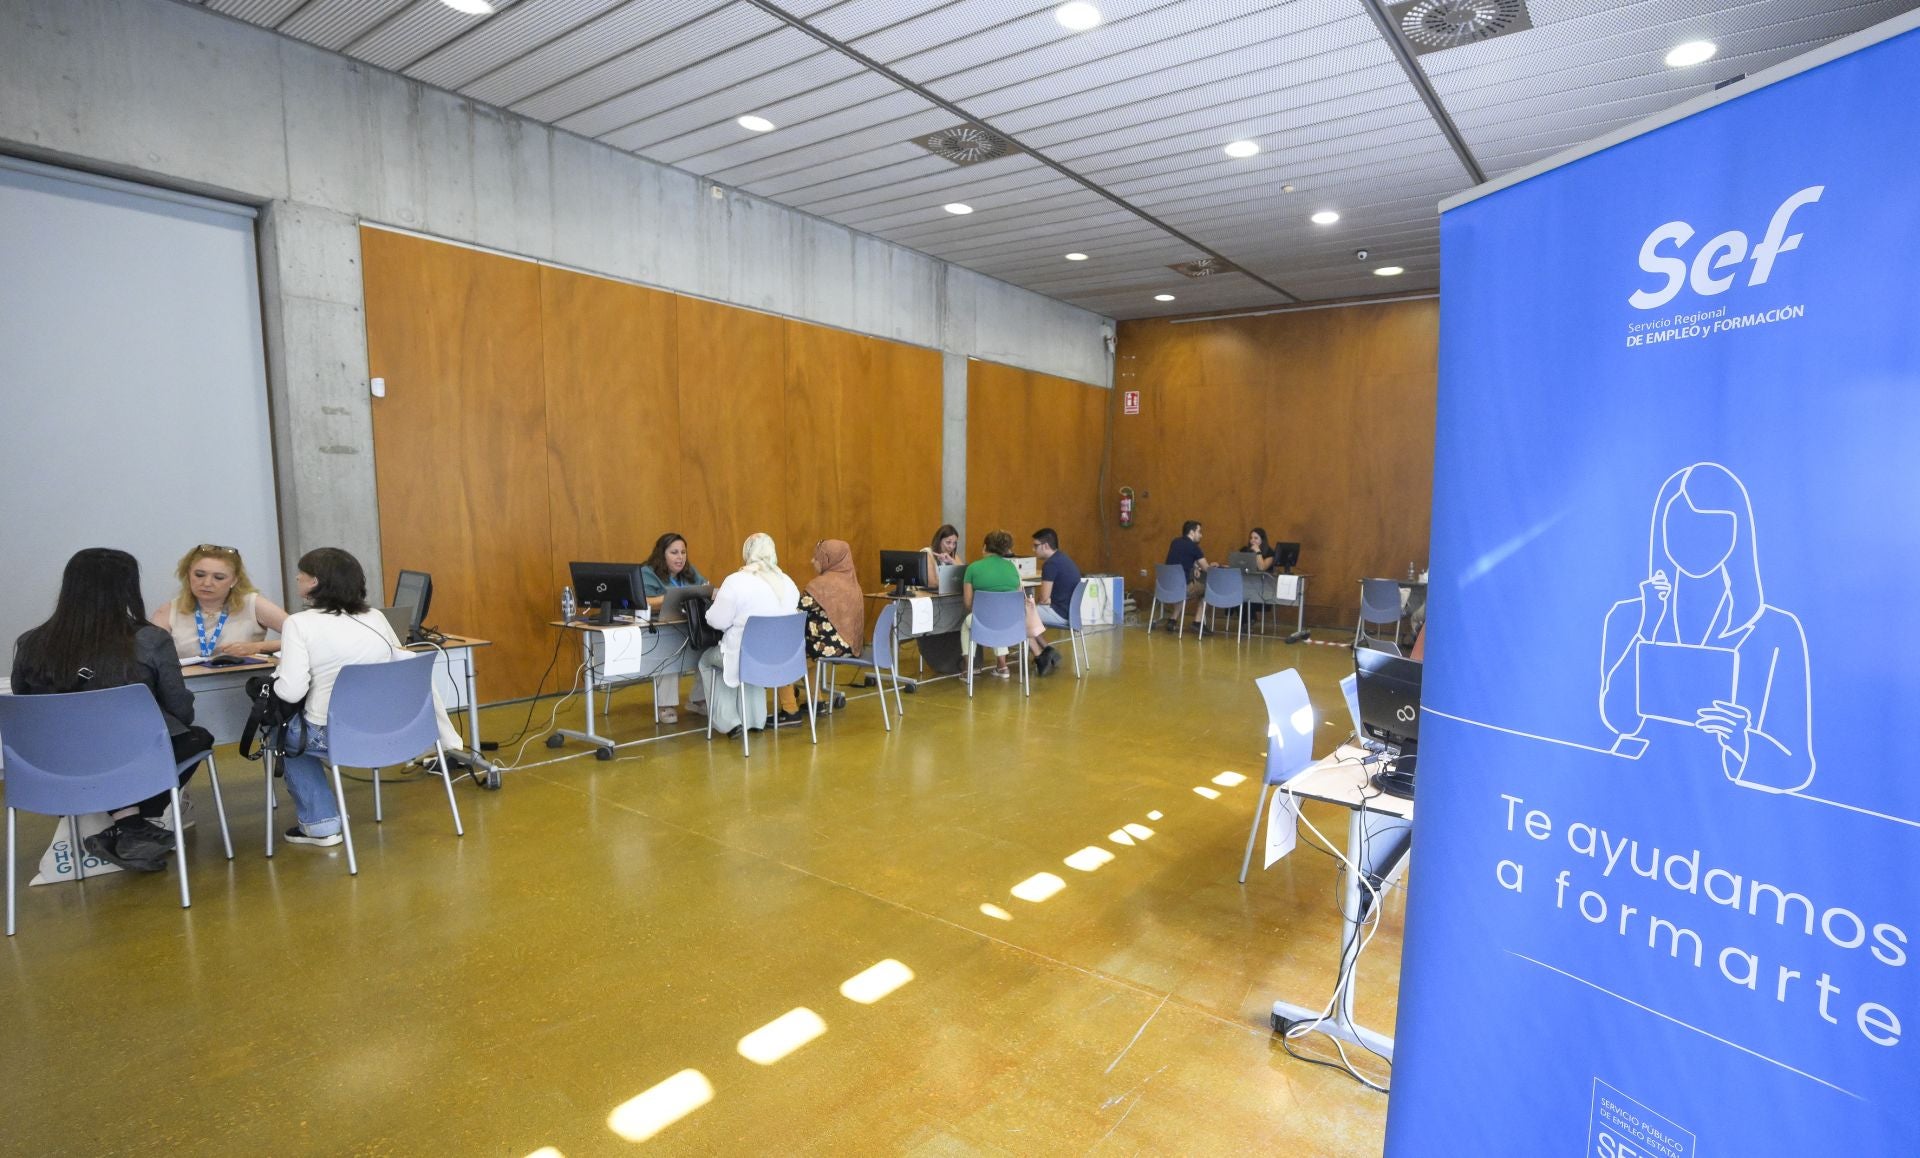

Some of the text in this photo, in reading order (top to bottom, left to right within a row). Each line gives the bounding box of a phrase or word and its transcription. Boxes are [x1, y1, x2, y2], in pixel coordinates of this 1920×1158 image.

[1628, 185, 1825, 310] Sef
[1626, 304, 1804, 347] DE EMPLEO y FORMACIÓN
[1628, 305, 1726, 334] Servicio Regional
[612, 628, 637, 662] 2
[1501, 793, 1909, 967] Te ayudamos
[1496, 859, 1902, 1048] a formarte
[1600, 1097, 1639, 1126] SERVICIO
[1600, 1108, 1611, 1120] DE
[1612, 1115, 1645, 1140] EMPLEO
